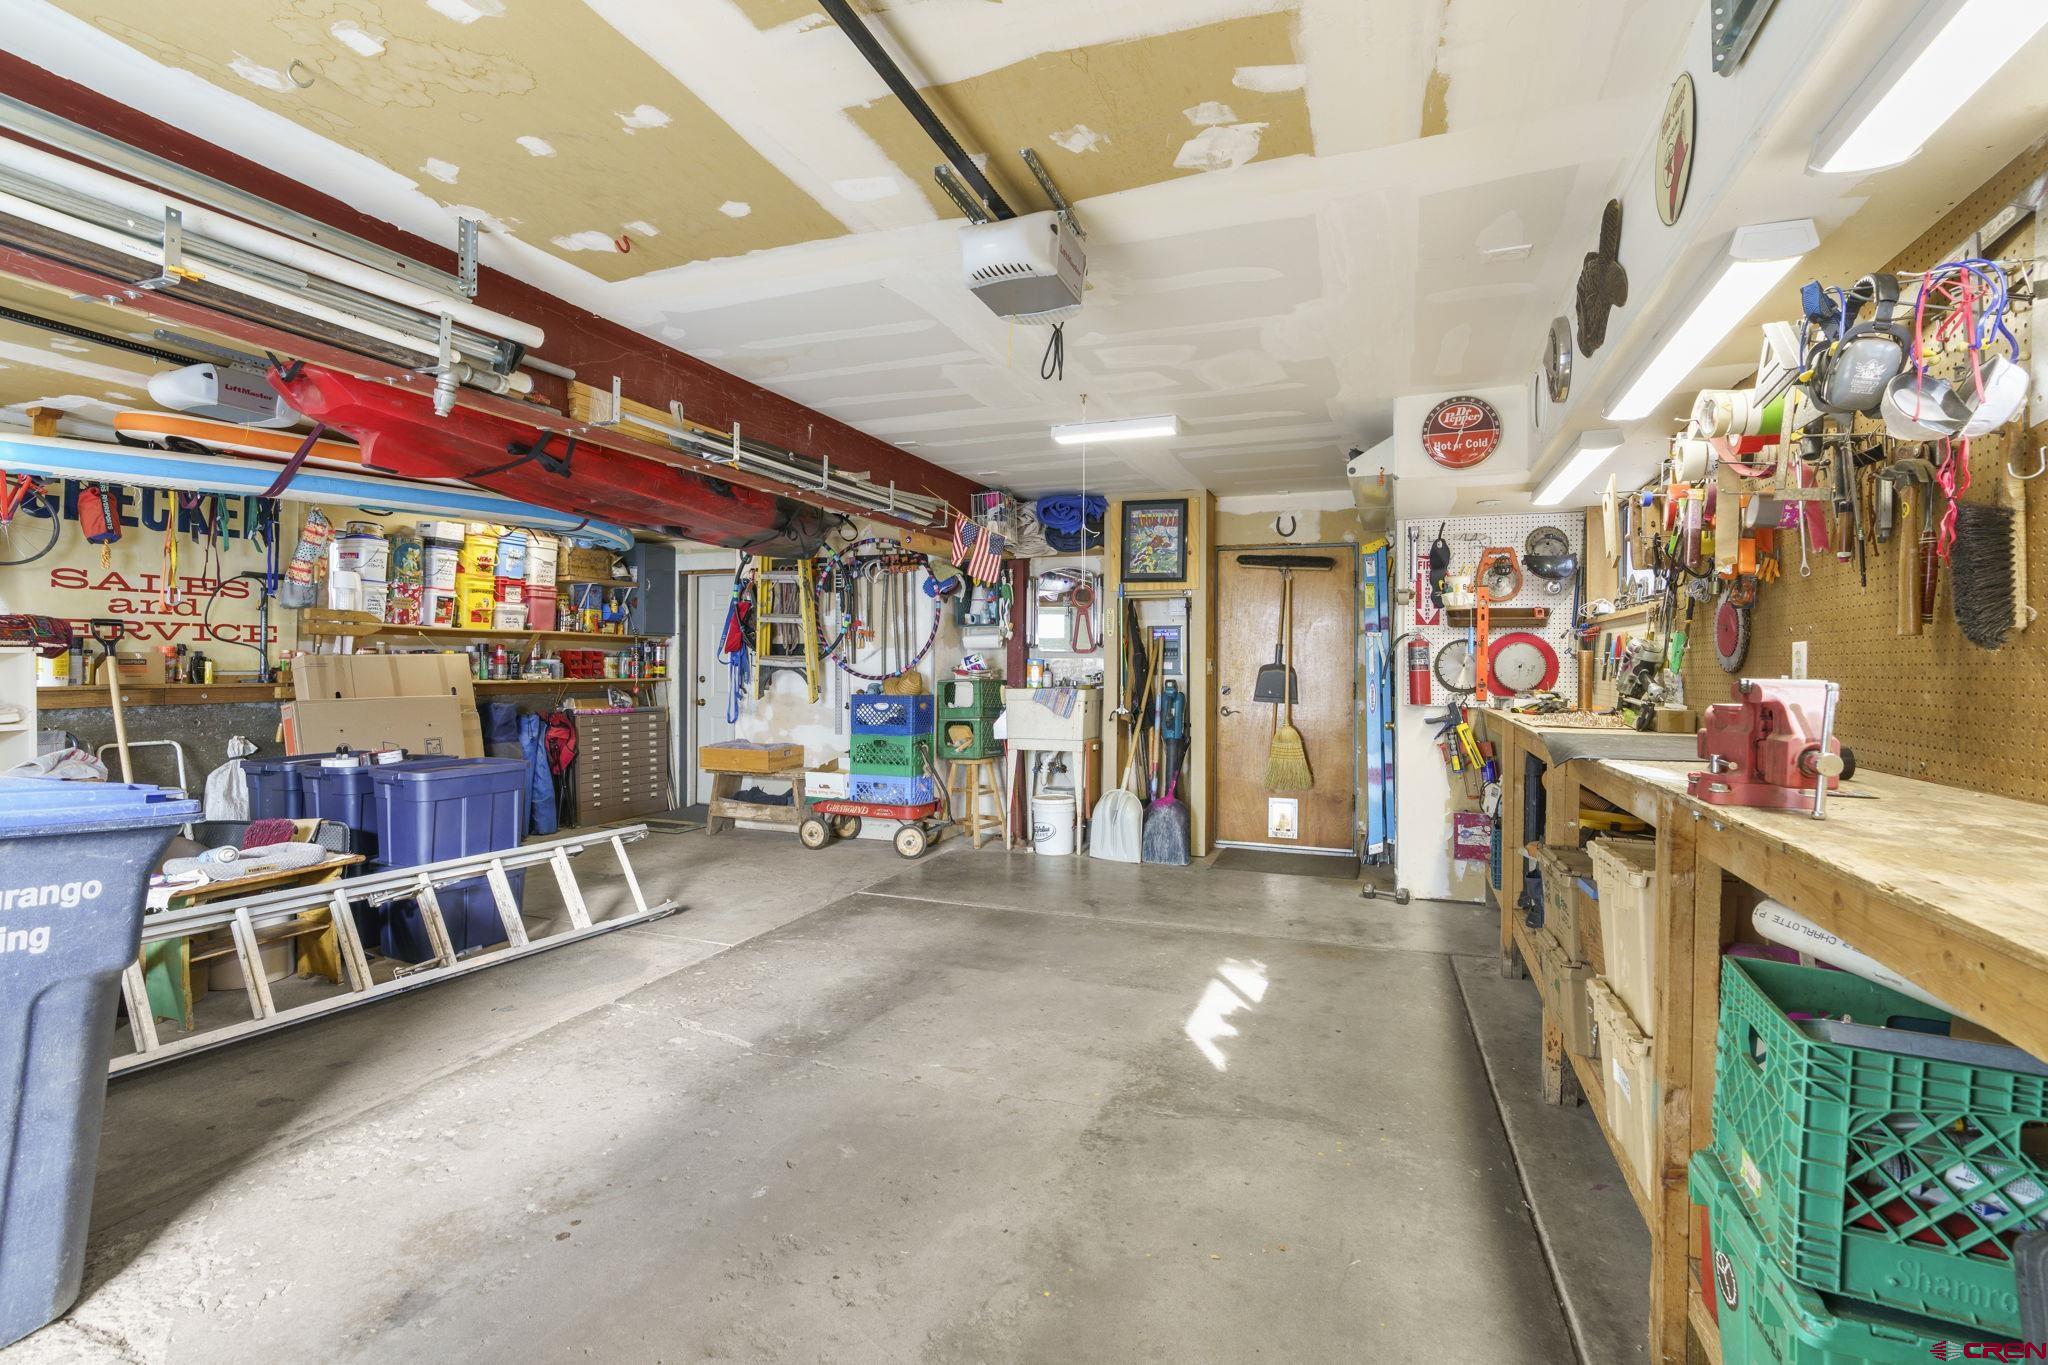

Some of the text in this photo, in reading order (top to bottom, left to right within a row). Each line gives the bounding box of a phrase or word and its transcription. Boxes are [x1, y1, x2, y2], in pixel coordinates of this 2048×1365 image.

[225, 383, 274, 401] LiftMaster
[1444, 413, 1480, 426] Pepper
[1456, 406, 1473, 416] Dr
[1433, 441, 1452, 451] Hot
[1465, 438, 1488, 449] Cold
[1417, 561, 1432, 571] FIR
[50, 567, 250, 599] SALES
[108, 596, 202, 617] and
[56, 618, 278, 643] ERVICE
[0, 879, 103, 911] rango
[1771, 914, 1838, 945] CHARLOTTE
[1896, 1257, 2019, 1315] Shamro
